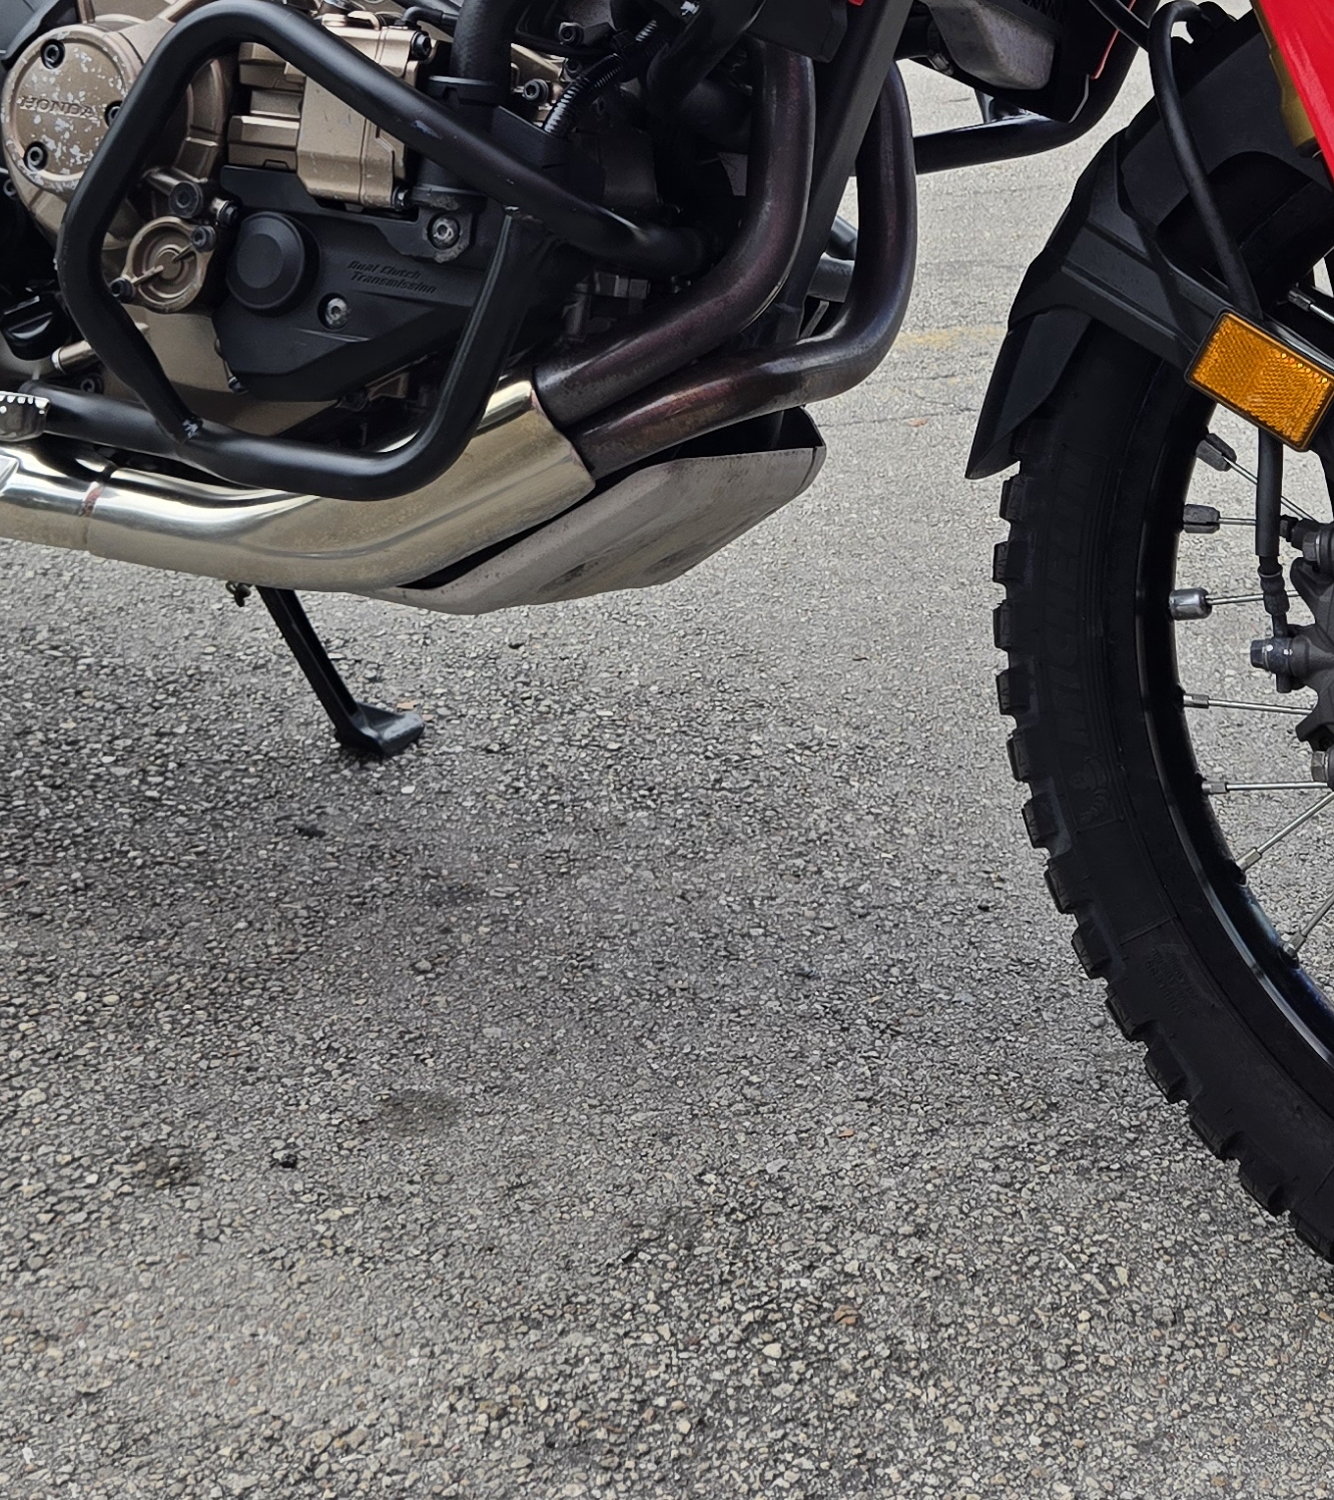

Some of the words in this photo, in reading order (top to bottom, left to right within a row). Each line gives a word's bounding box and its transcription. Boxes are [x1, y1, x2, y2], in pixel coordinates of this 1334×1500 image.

[20, 96, 99, 119] HONDA
[348, 260, 380, 273] Dual
[380, 265, 421, 280] Clutch
[351, 271, 437, 294] Transmission
